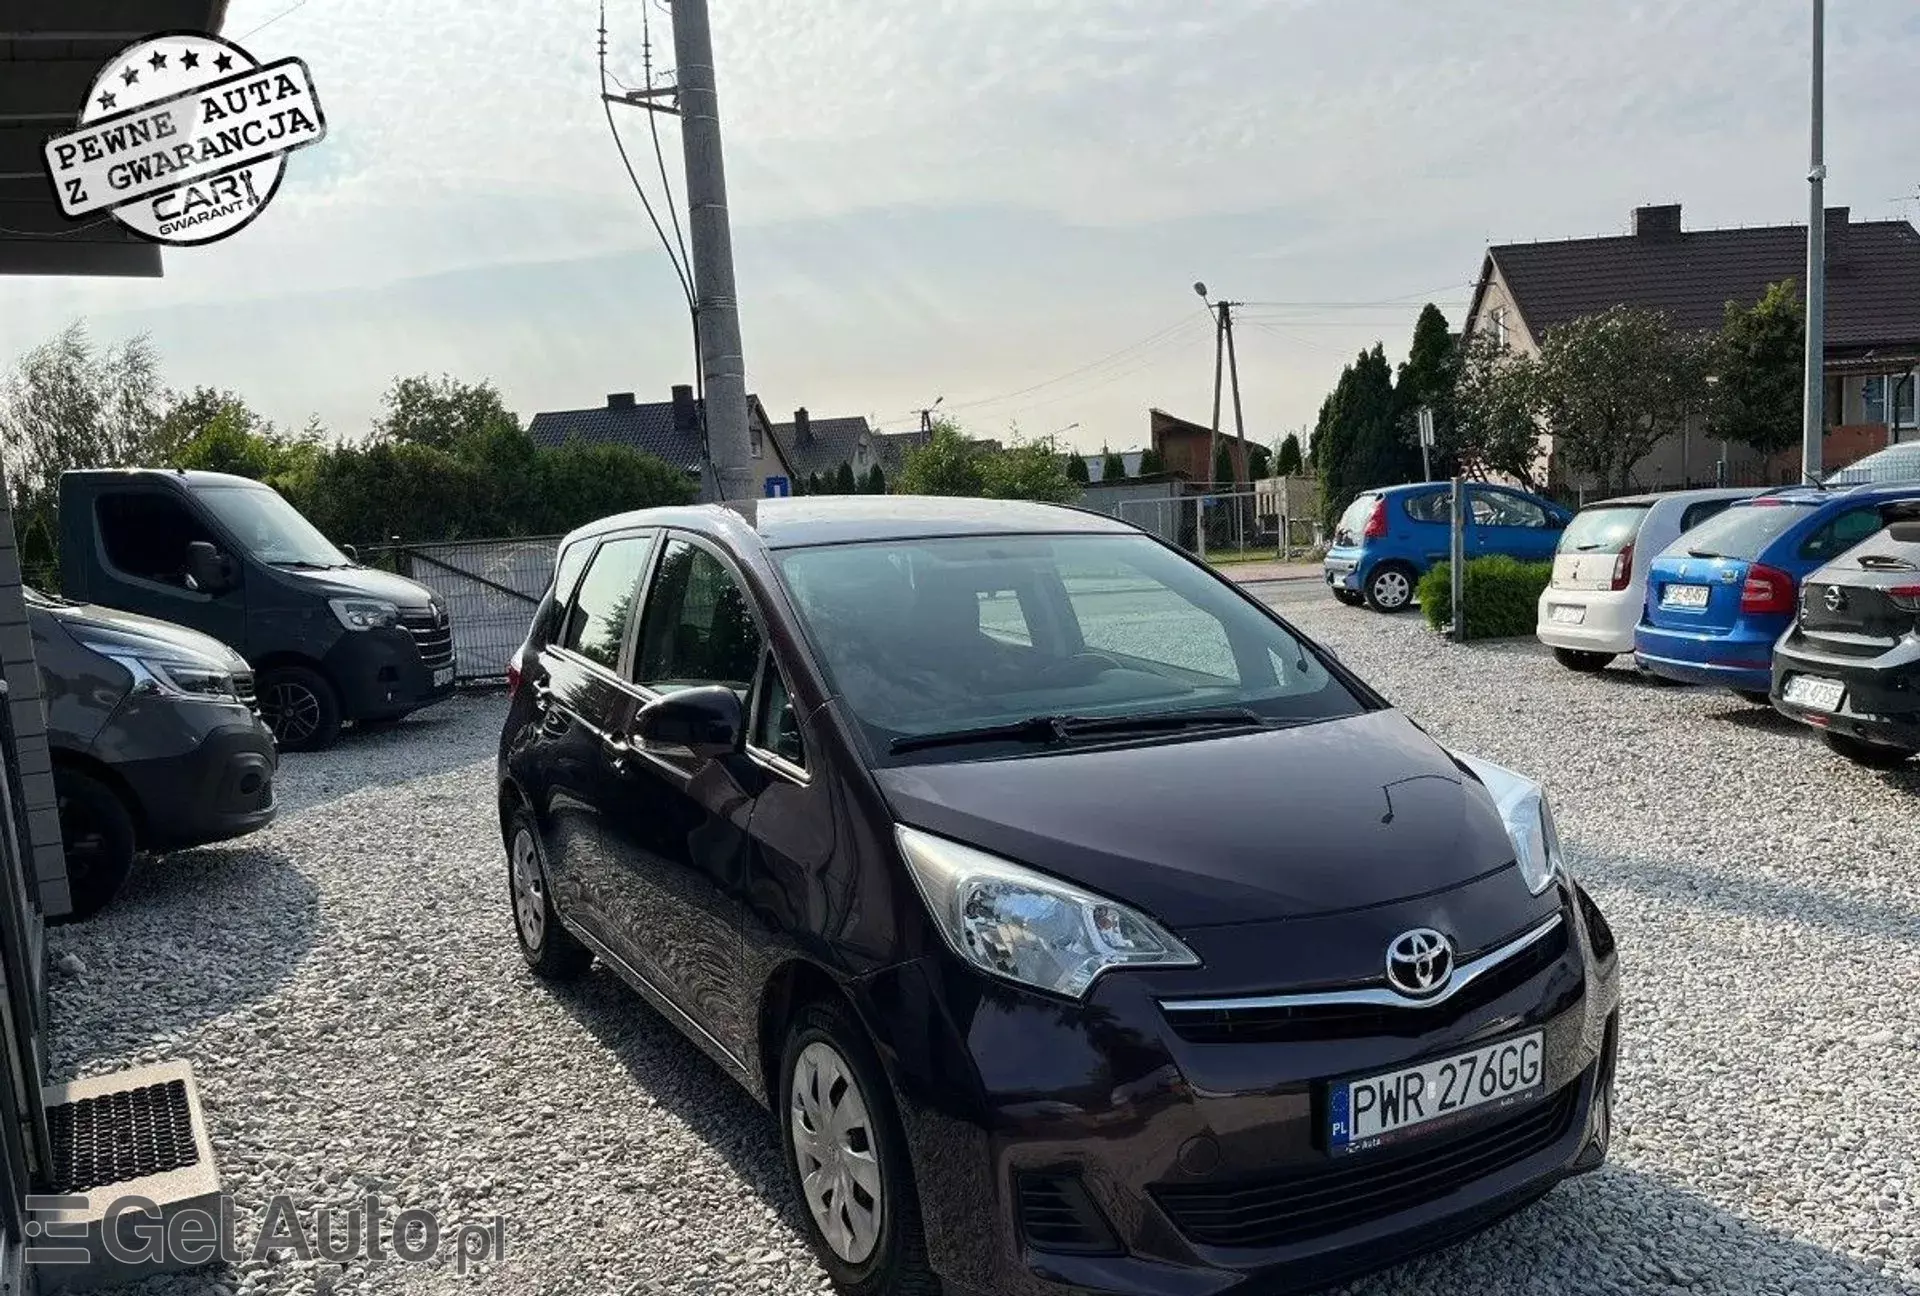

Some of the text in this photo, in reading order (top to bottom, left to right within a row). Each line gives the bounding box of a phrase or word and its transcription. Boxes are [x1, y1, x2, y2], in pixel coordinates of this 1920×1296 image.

[1353, 1072, 1425, 1135] PWR
[1438, 1039, 1539, 1112] 276GG
[1332, 1122, 1347, 1136] PL
